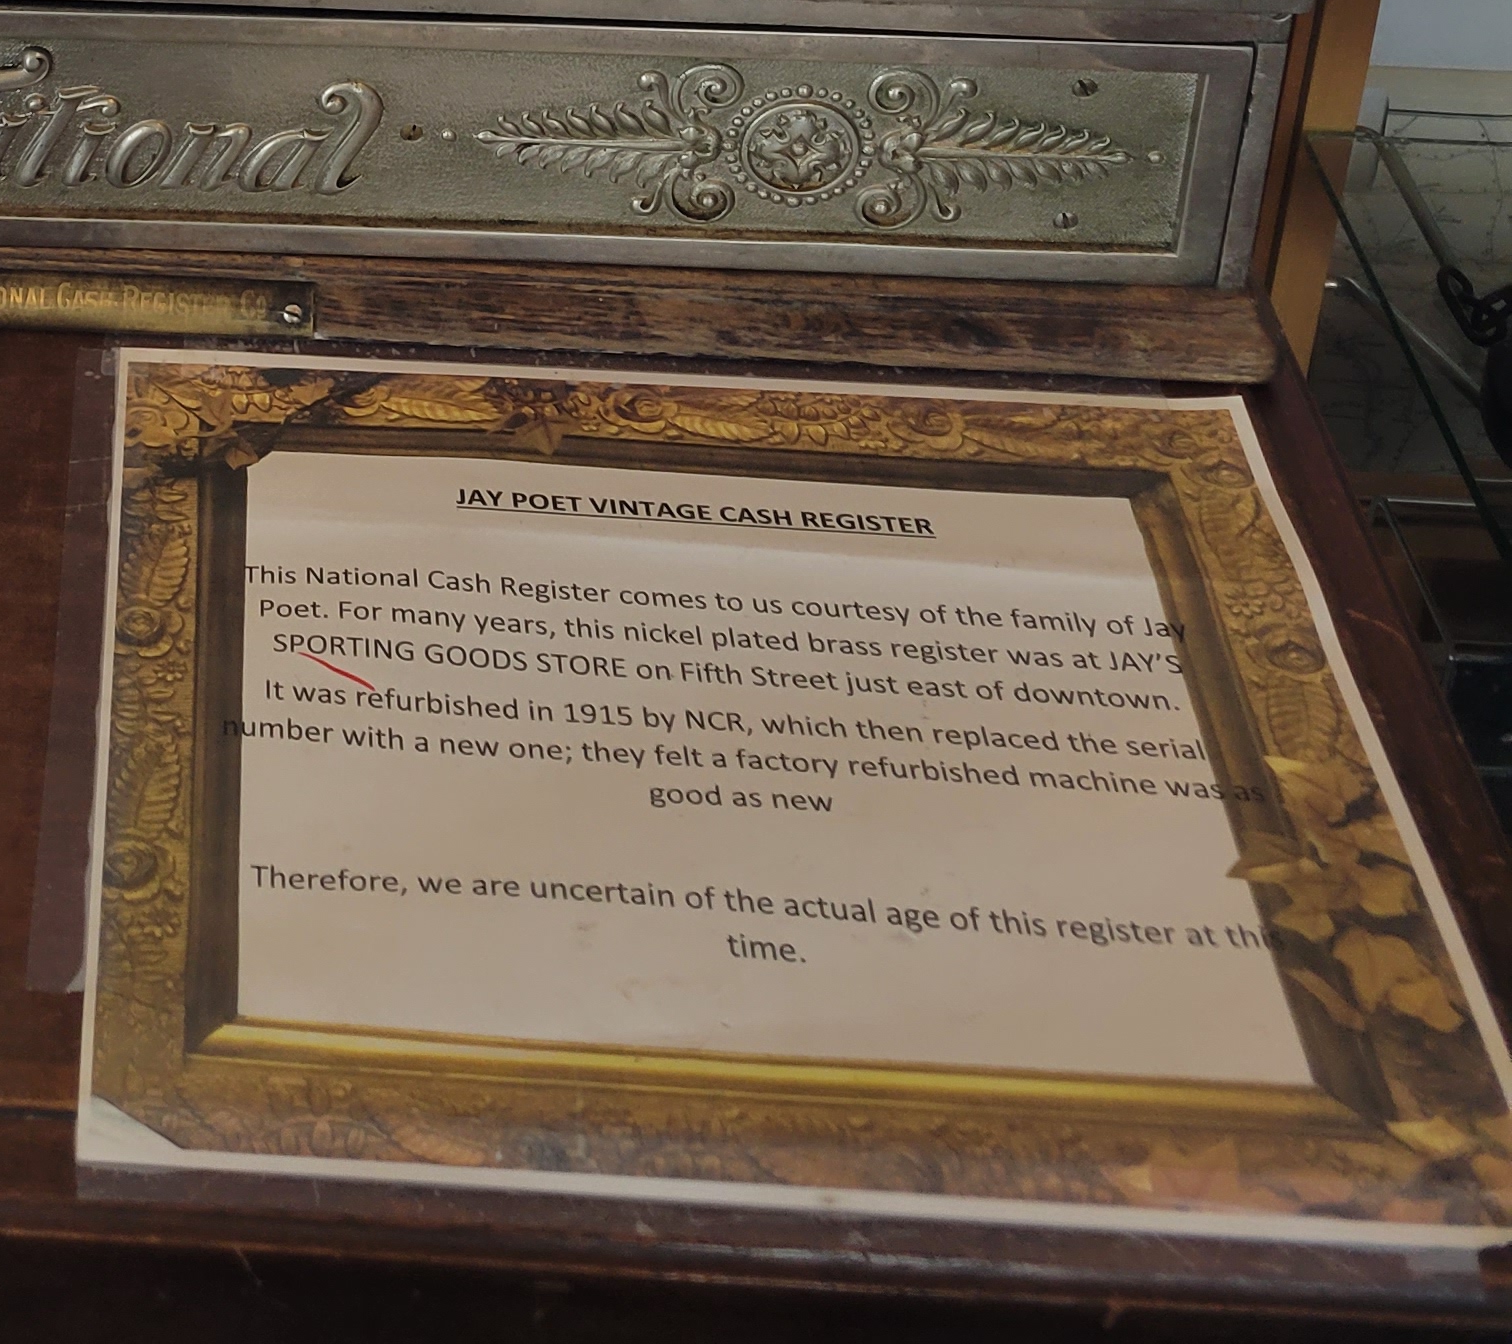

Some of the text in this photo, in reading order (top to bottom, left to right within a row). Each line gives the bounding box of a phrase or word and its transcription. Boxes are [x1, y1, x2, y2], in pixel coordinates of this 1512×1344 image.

[456, 488, 935, 535] JAY POET VINTAGE CASH REGISTER
[245, 566, 1186, 643] This National Cash Register comes to us courtesy of the family of Jay
[259, 600, 1183, 675] Poet. For many years, this nickel plated brass register was at JAY'S
[250, 863, 1284, 952] Therefore, we are uncertain of the actual age of this register at this
[727, 933, 807, 963] time.
